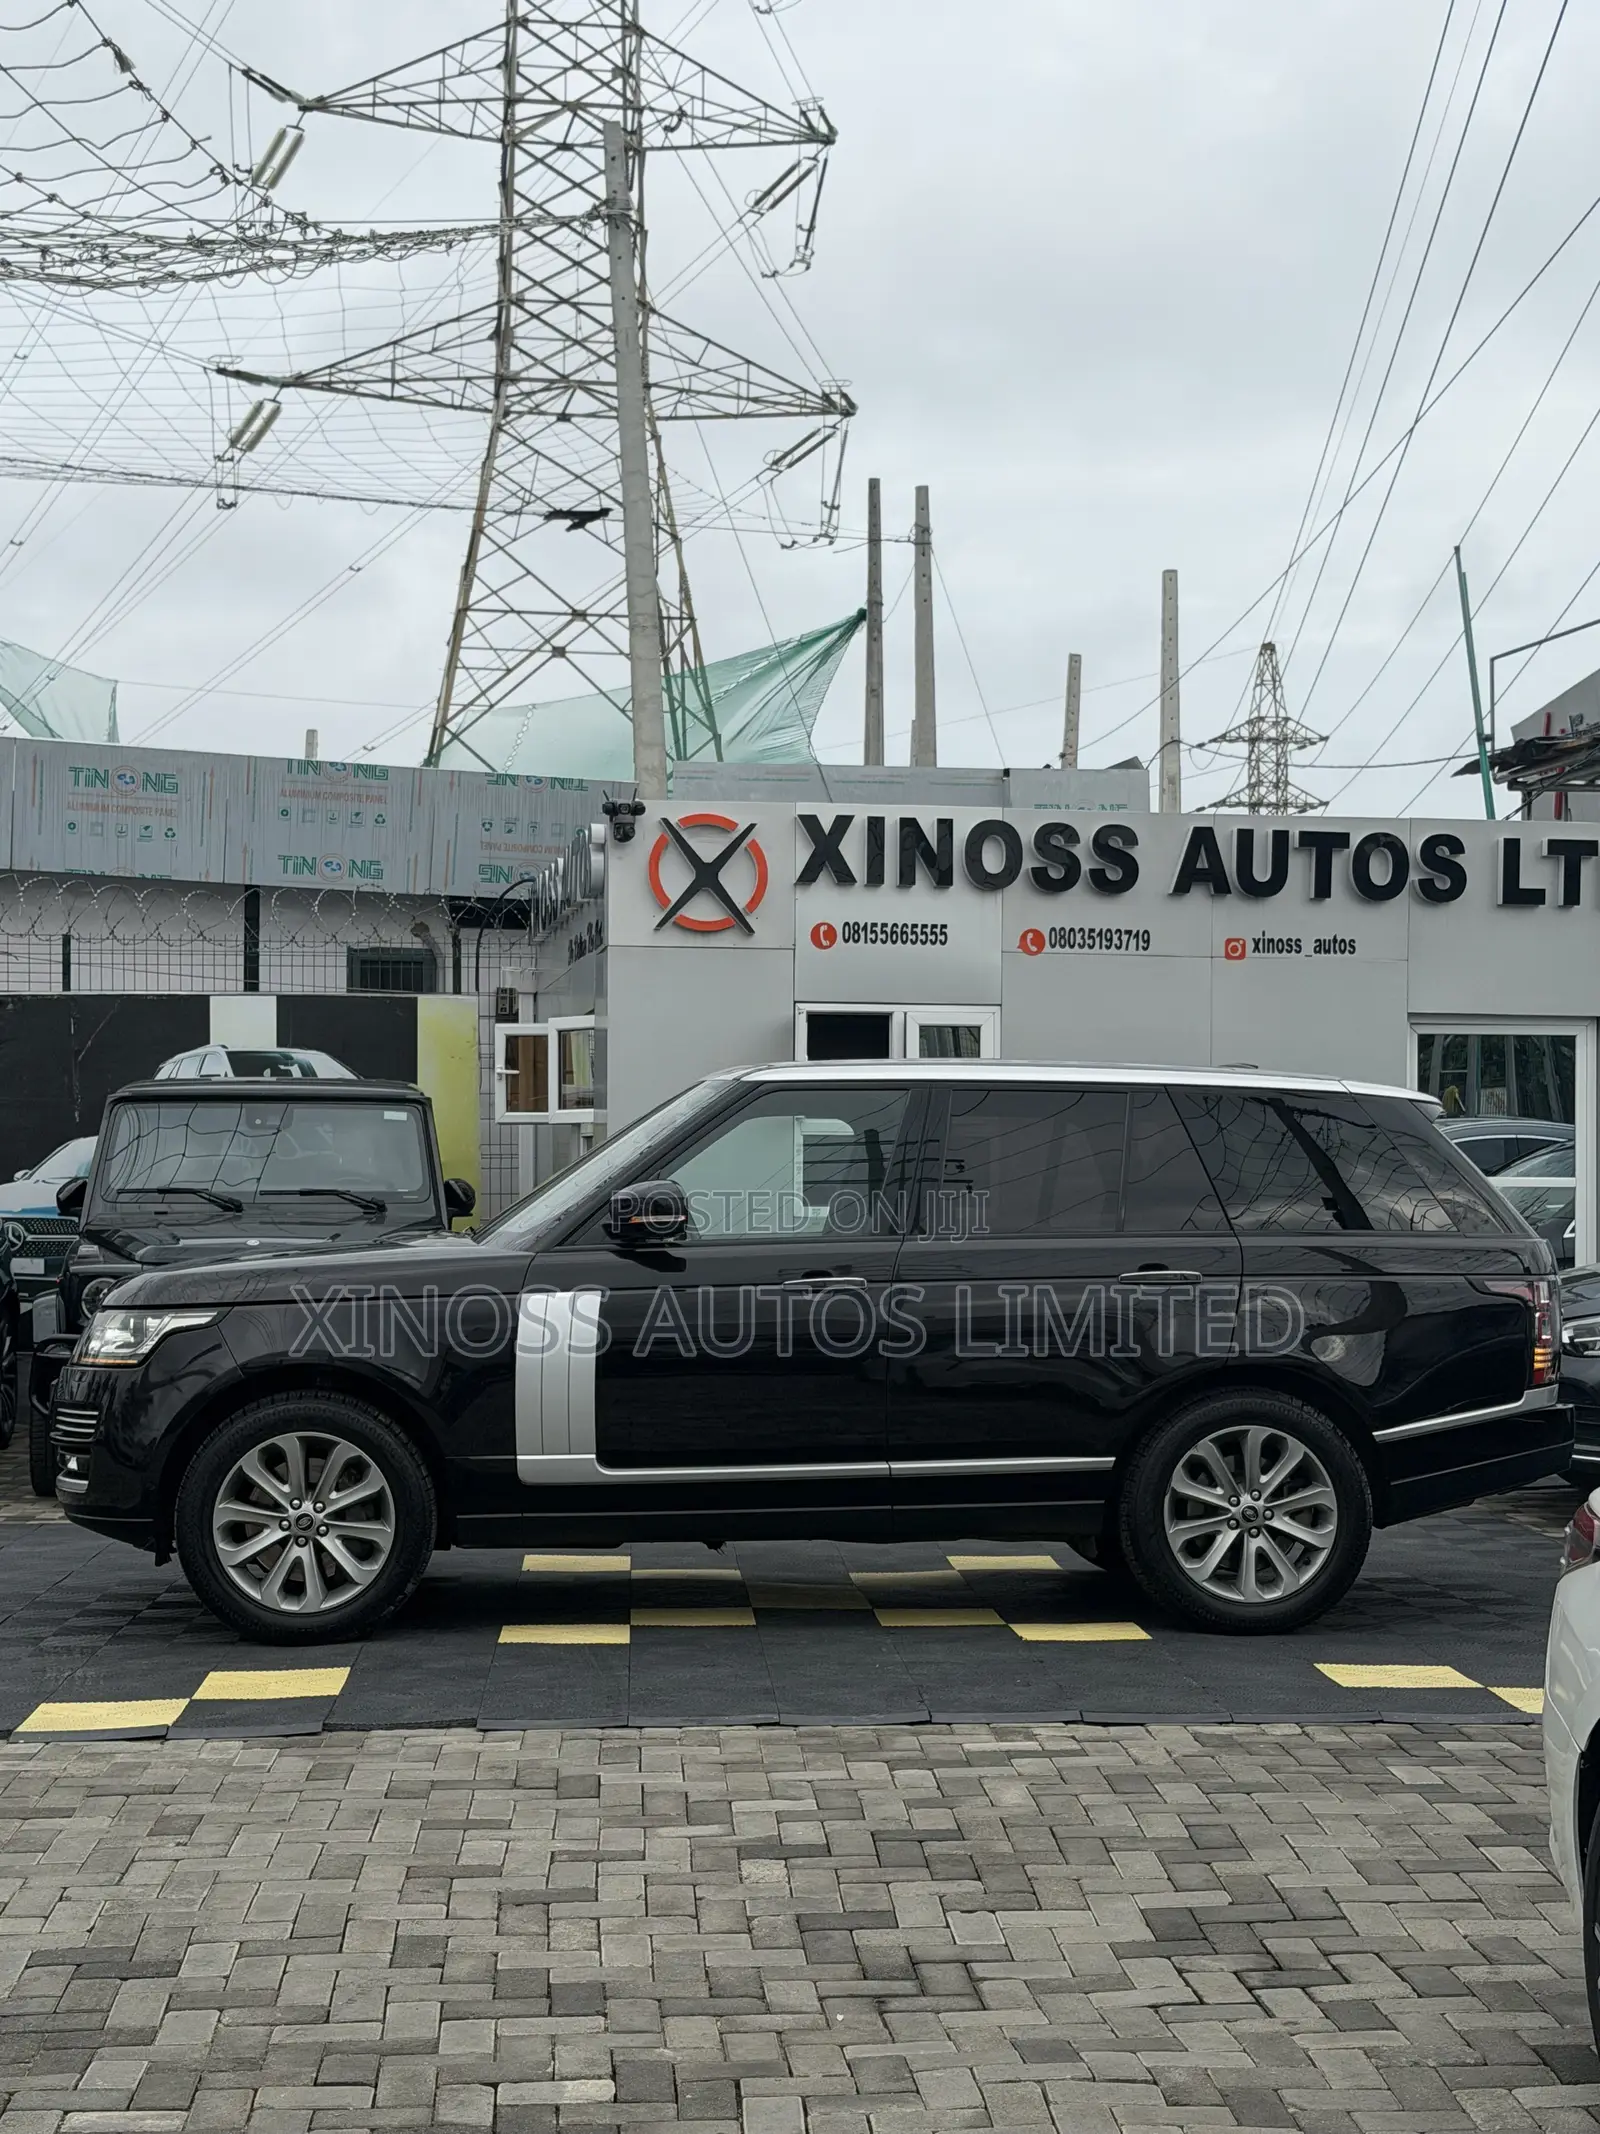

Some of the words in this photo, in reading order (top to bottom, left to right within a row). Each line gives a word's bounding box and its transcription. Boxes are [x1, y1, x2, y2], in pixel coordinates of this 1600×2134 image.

[794, 813, 1139, 895] XINOSS
[1168, 825, 1467, 904] AUTOS
[842, 921, 948, 946] 08155665555
[1048, 926, 1151, 952] 08035193719
[1251, 930, 1357, 958] xinoss_autos
